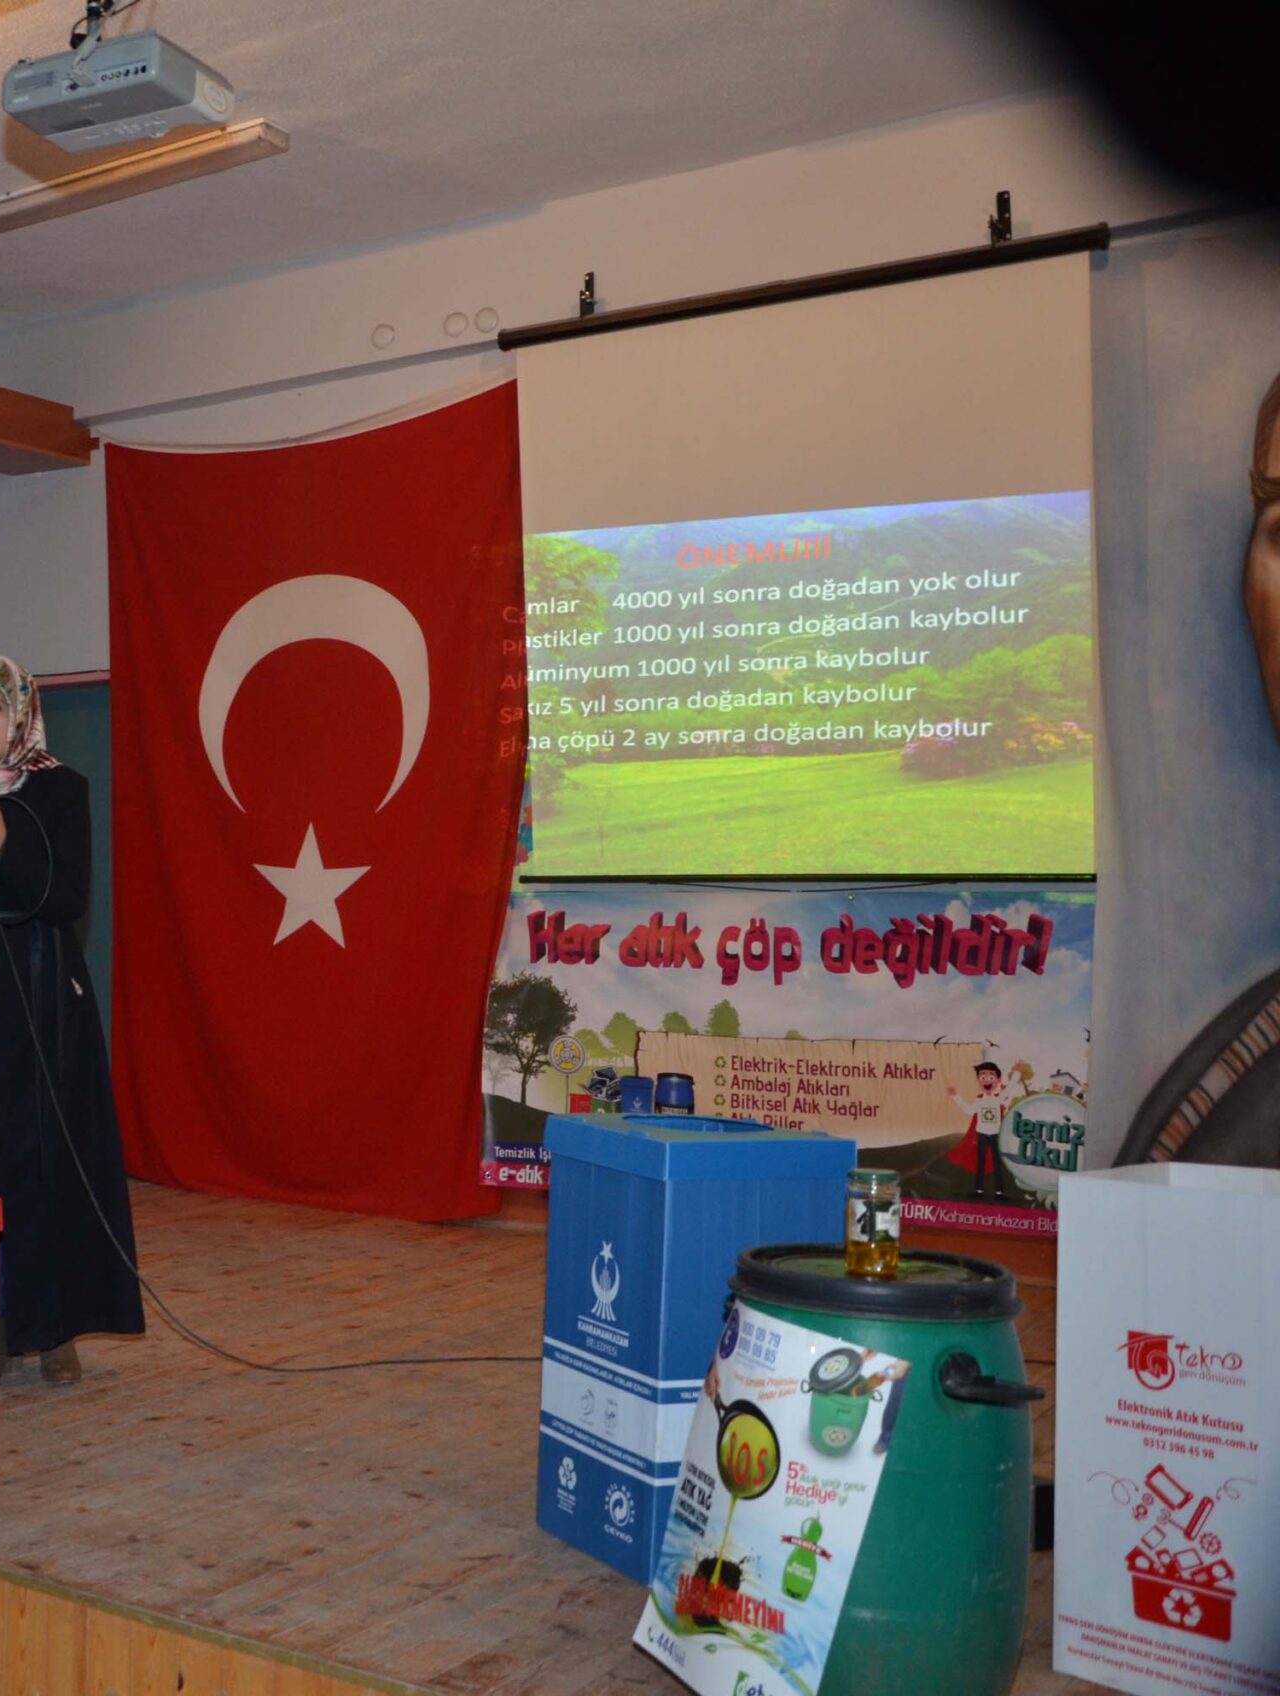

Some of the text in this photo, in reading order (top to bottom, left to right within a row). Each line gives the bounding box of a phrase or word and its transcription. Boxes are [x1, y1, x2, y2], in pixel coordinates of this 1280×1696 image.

[612, 590, 671, 610] 4000
[678, 587, 704, 609] yıl
[712, 584, 780, 603] sonra
[789, 577, 899, 601] doğadan
[909, 571, 956, 596] yok
[965, 569, 1021, 589] olur
[614, 623, 671, 644] 1000
[678, 621, 704, 643] yıl
[712, 619, 780, 638] sonra
[789, 613, 899, 637] doğadan
[910, 605, 1029, 630] kaybolur
[638, 658, 696, 677] 1000
[703, 655, 730, 676] yıl
[738, 653, 807, 672] sonra
[816, 646, 930, 671] kaybolur
[559, 697, 573, 715] 5
[580, 695, 606, 717] yıl
[614, 694, 679, 712] sonra
[687, 688, 793, 713] doğadan
[804, 683, 917, 707] kaybolur
[558, 729, 615, 752] çöpü
[622, 729, 636, 746] 2
[644, 731, 671, 748] ay
[678, 726, 745, 744] sonra
[753, 722, 863, 746] doğadan
[874, 717, 992, 742] kaybolur
[527, 910, 1054, 989] Her atık çöp değildir!
[731, 1056, 936, 1080] Elektrik-Elektronik Atıklar
[730, 1074, 850, 1097] Ambalaj Atıkları
[730, 1093, 880, 1121] Bitkisel Atık Yağlar
[494, 1146, 536, 1160] Temizlik
[499, 1165, 544, 1184] e-atık
[1118, 1398, 1244, 1433] Elektronik Atık Kutusu
[785, 1481, 837, 1504] Hediye
